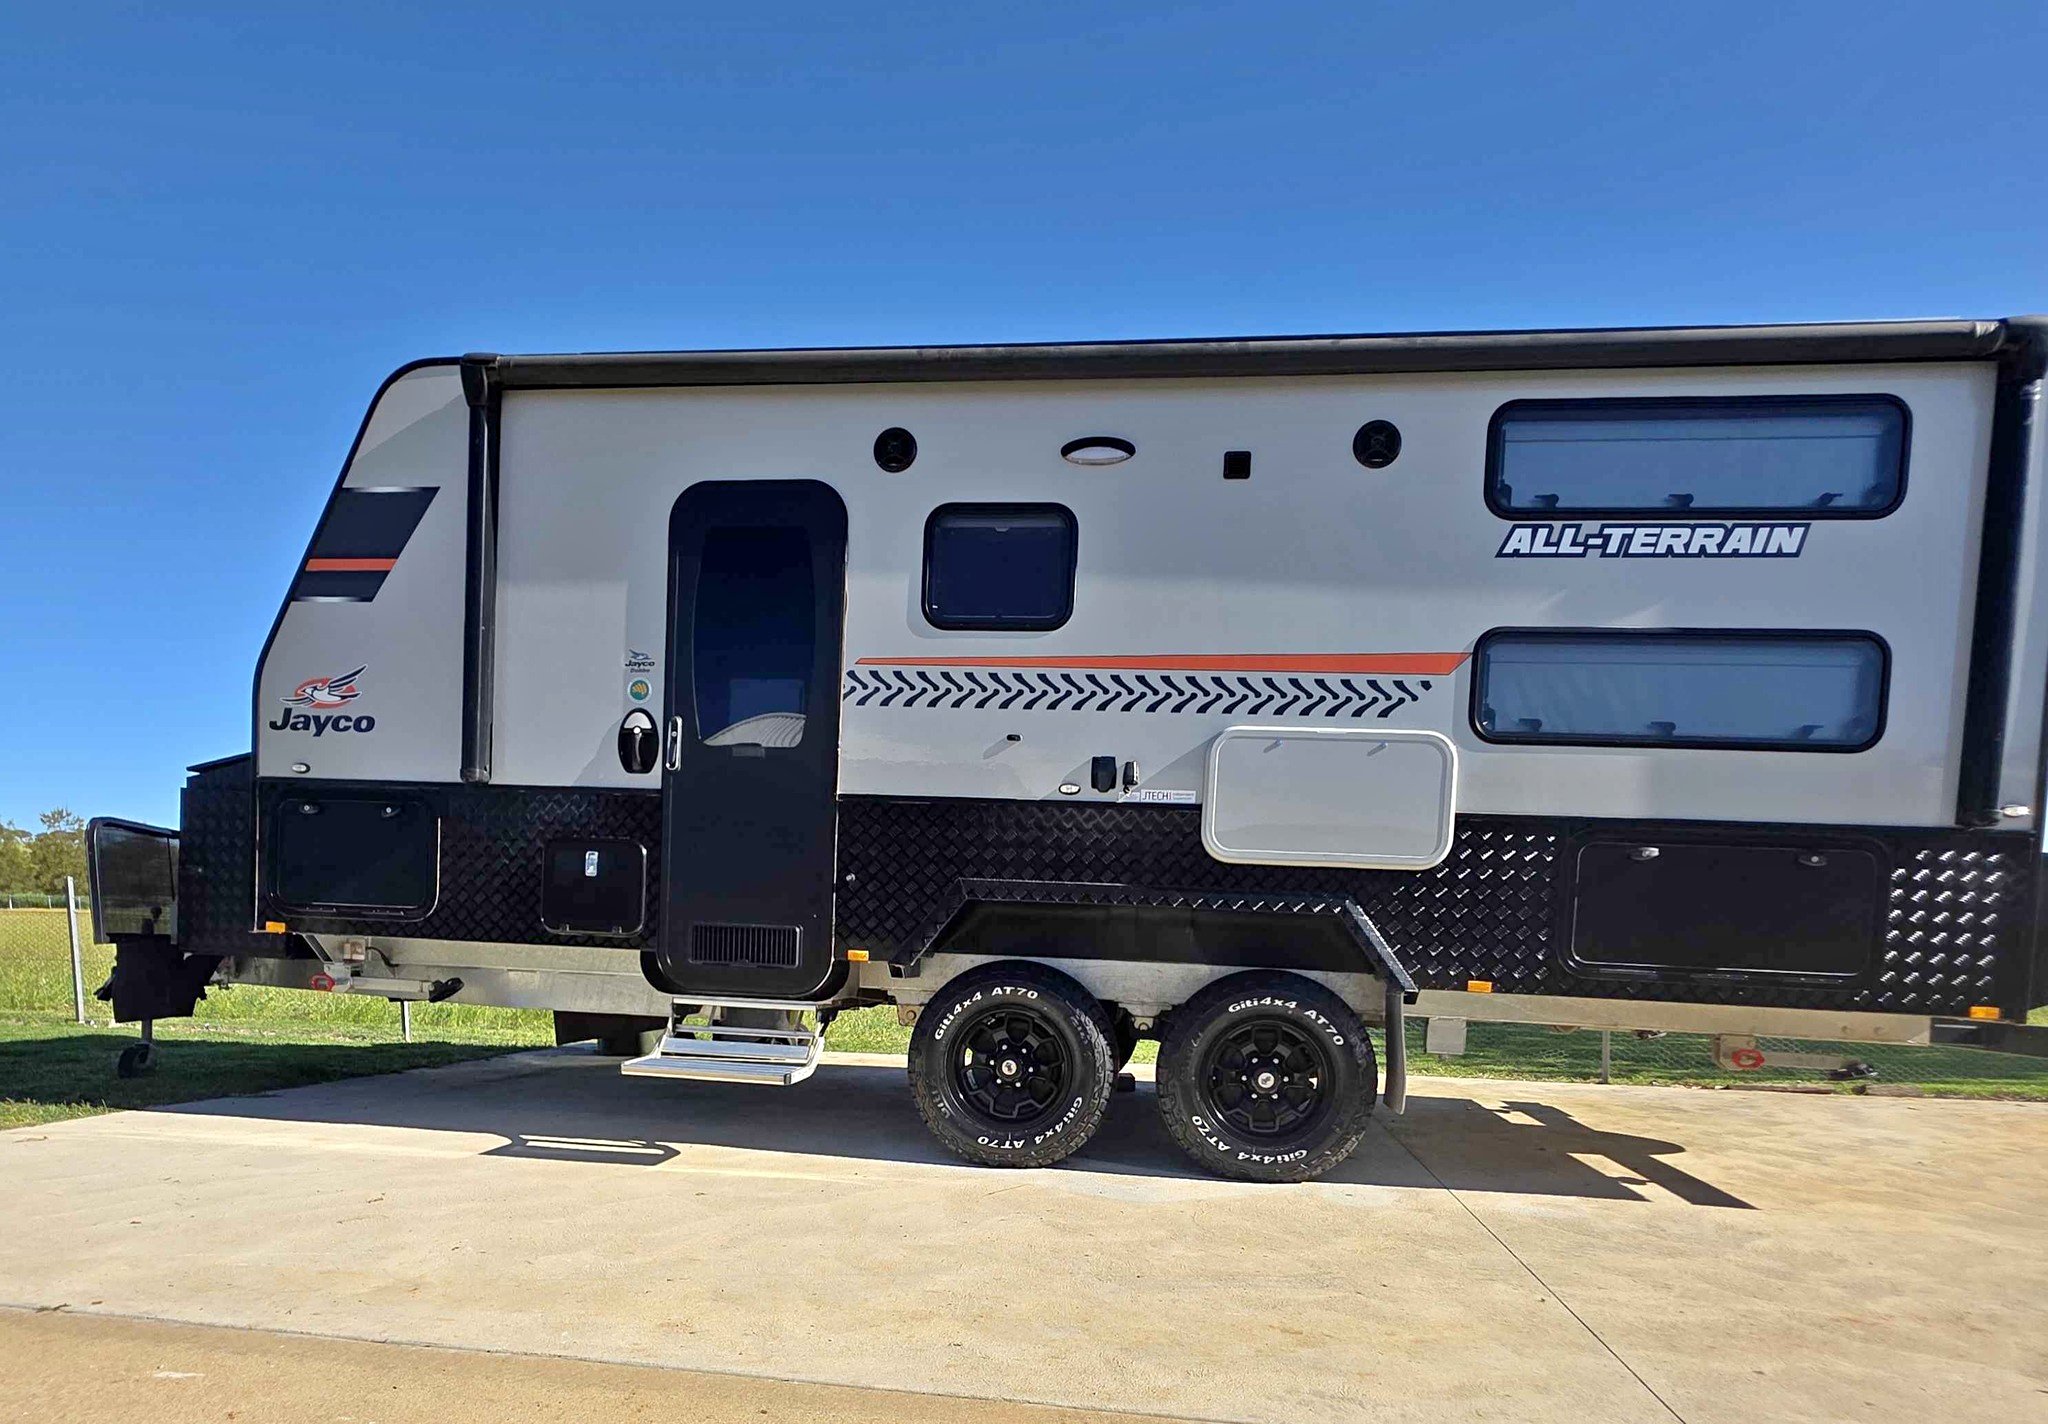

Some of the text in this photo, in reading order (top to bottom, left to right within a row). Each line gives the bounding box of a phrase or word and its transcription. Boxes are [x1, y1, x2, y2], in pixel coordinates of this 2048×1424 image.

[1497, 524, 1809, 557] ALL-TERRAIN
[625, 659, 655, 668] Jayco
[269, 707, 376, 737] Jayco
[991, 986, 1039, 999] AT70
[1303, 1009, 1345, 1046] AT70
[977, 1135, 1025, 1149] AT70
[1191, 1115, 1232, 1151] AT70
